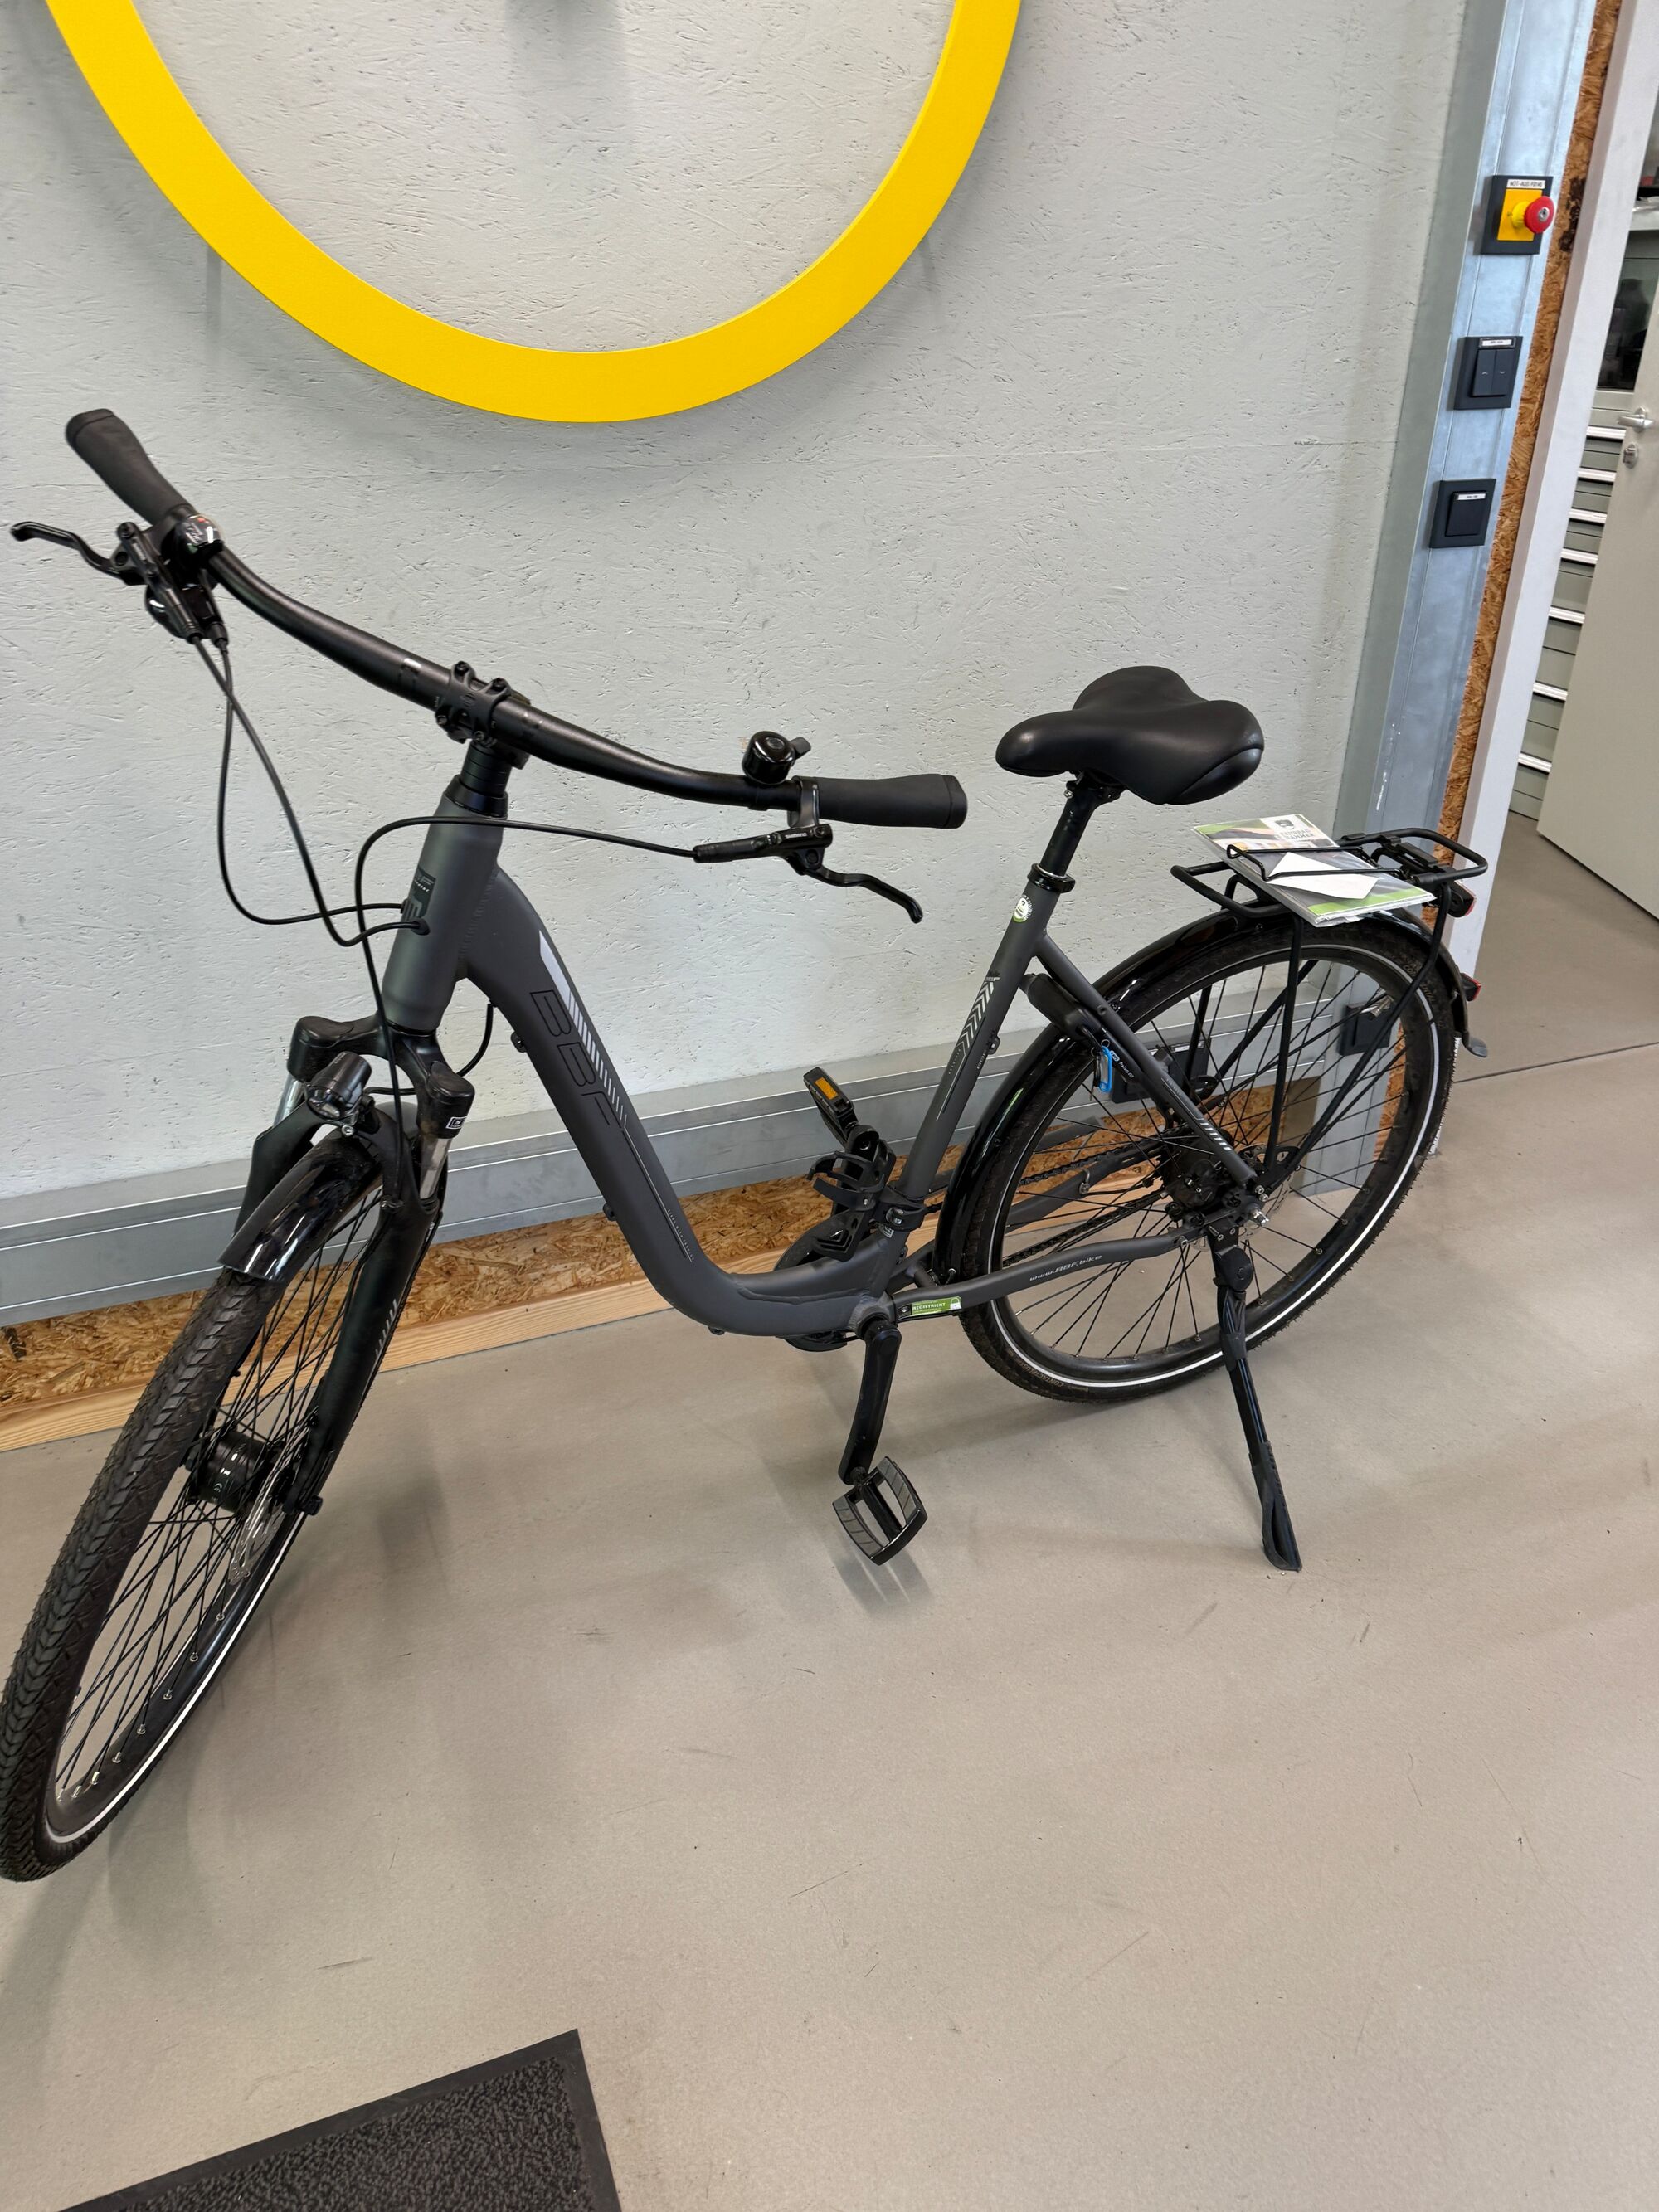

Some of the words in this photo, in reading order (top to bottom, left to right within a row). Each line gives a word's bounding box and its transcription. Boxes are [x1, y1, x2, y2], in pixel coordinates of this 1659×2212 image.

[529, 990, 622, 1129] BBF
[1029, 1255, 1102, 1281] www.BBF.bike
[912, 1302, 946, 1310] REGISTRIERT
